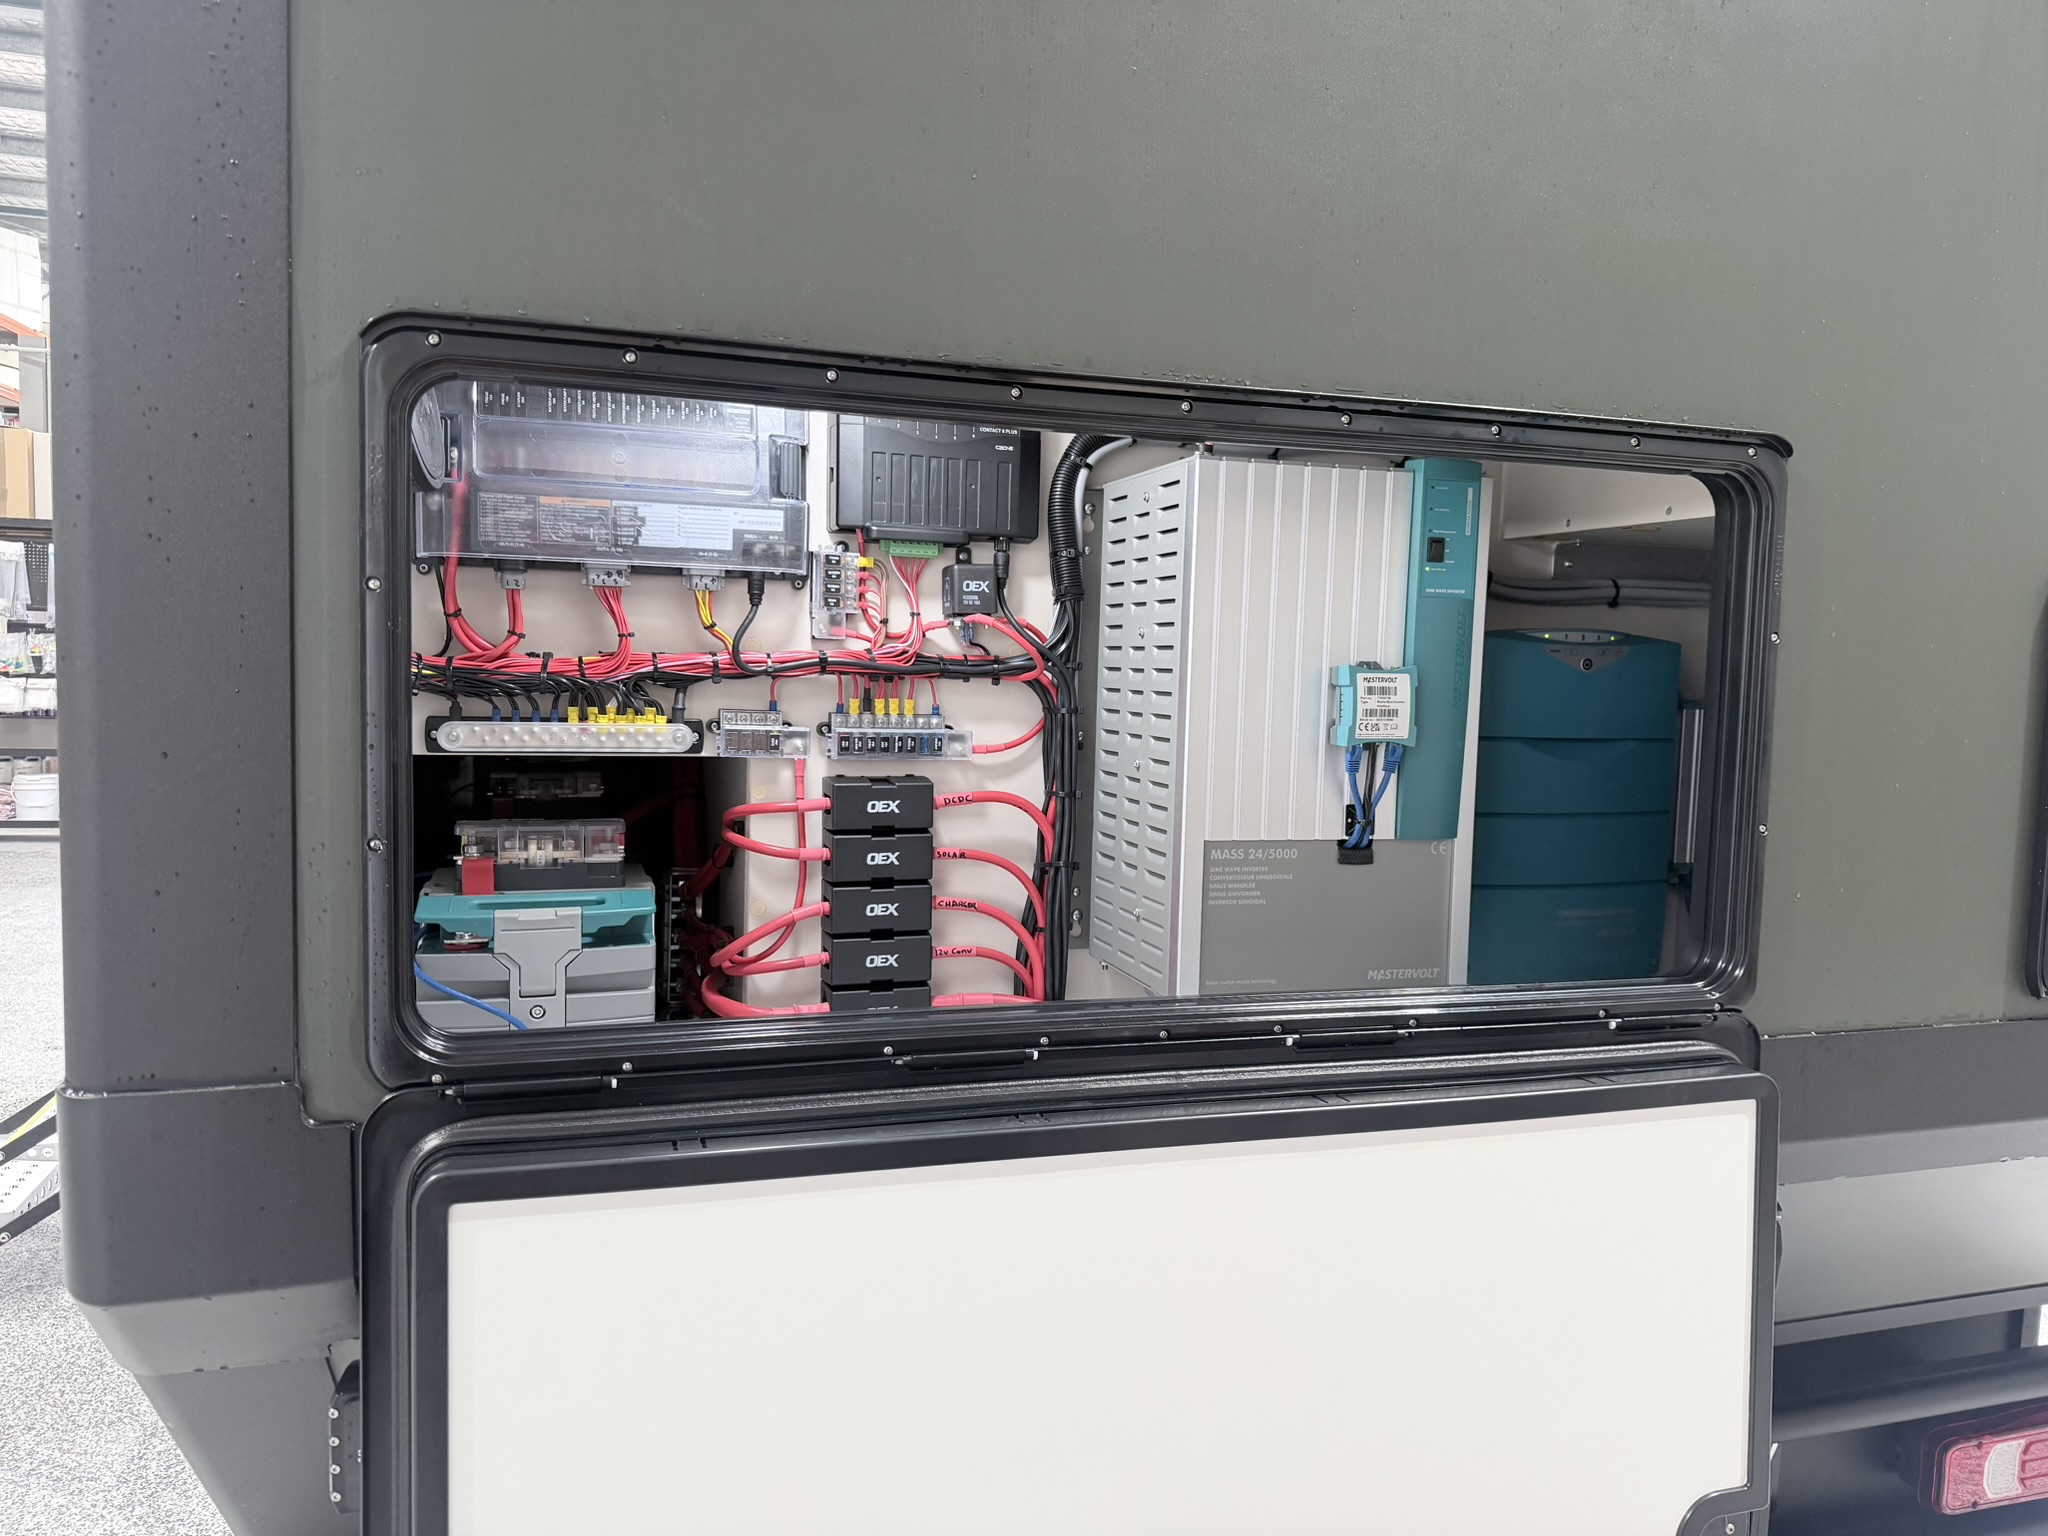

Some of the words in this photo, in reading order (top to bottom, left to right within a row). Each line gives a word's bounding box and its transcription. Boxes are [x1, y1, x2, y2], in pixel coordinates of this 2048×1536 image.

[963, 580, 990, 593] OEX
[1452, 608, 1468, 709] MASTERVOLT
[1358, 723, 1369, 731] CE
[867, 800, 900, 813] OEX
[943, 795, 972, 806] DCDC
[866, 852, 900, 865] OEX
[1210, 849, 1244, 859] MASS
[1248, 848, 1298, 860] 24/5000
[866, 903, 899, 916] OEX
[938, 900, 978, 910] CHARGER
[866, 954, 899, 968] OEX
[1367, 968, 1440, 982] MASTERVOLT
